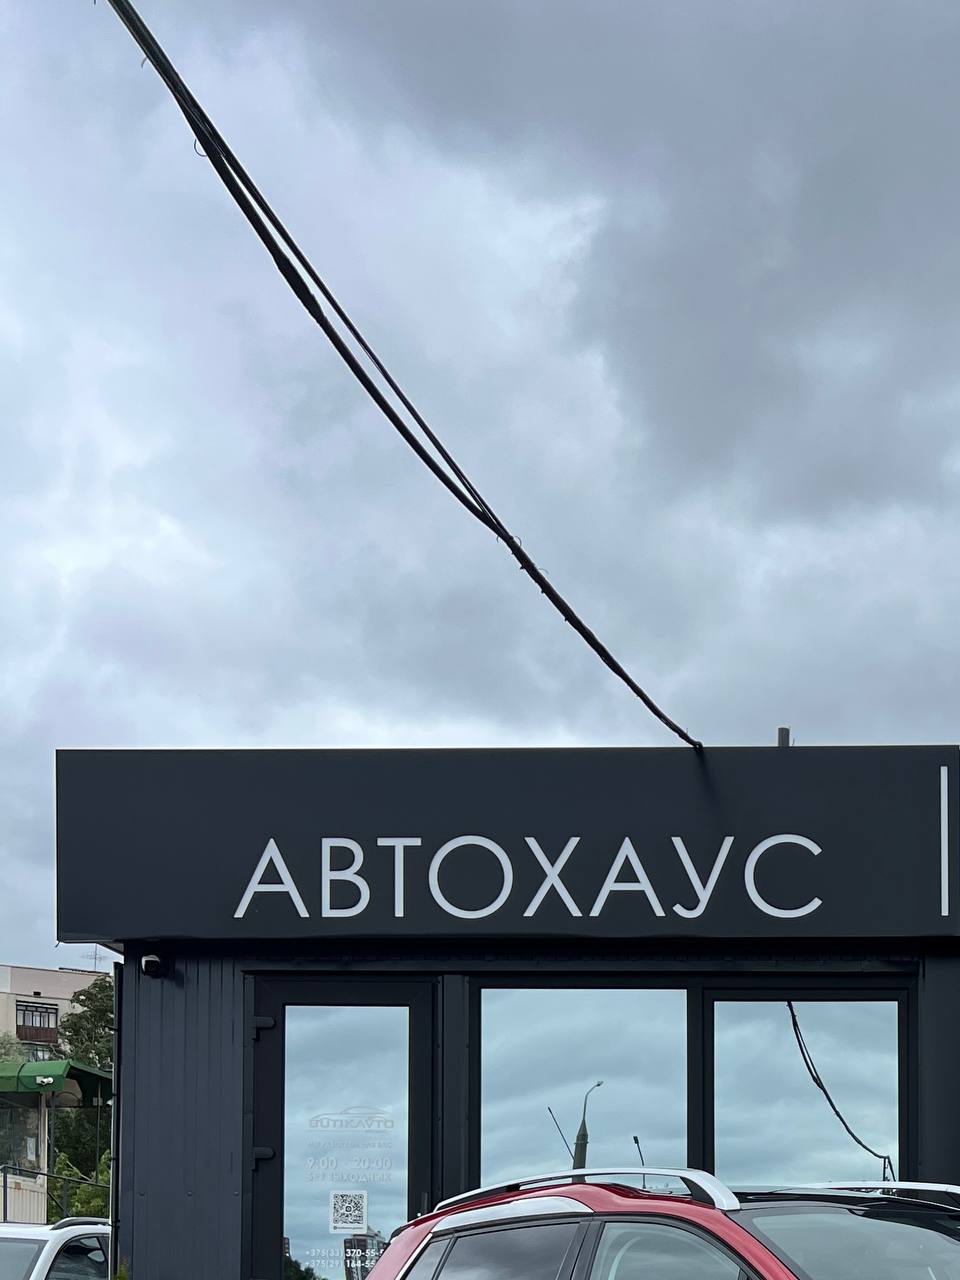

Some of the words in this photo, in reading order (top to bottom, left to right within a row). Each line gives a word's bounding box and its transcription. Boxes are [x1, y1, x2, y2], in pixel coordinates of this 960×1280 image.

[234, 835, 823, 918] АВТОХАУС
[346, 1249, 385, 1257] 370-55-
[346, 1259, 376, 1268] 164-55
